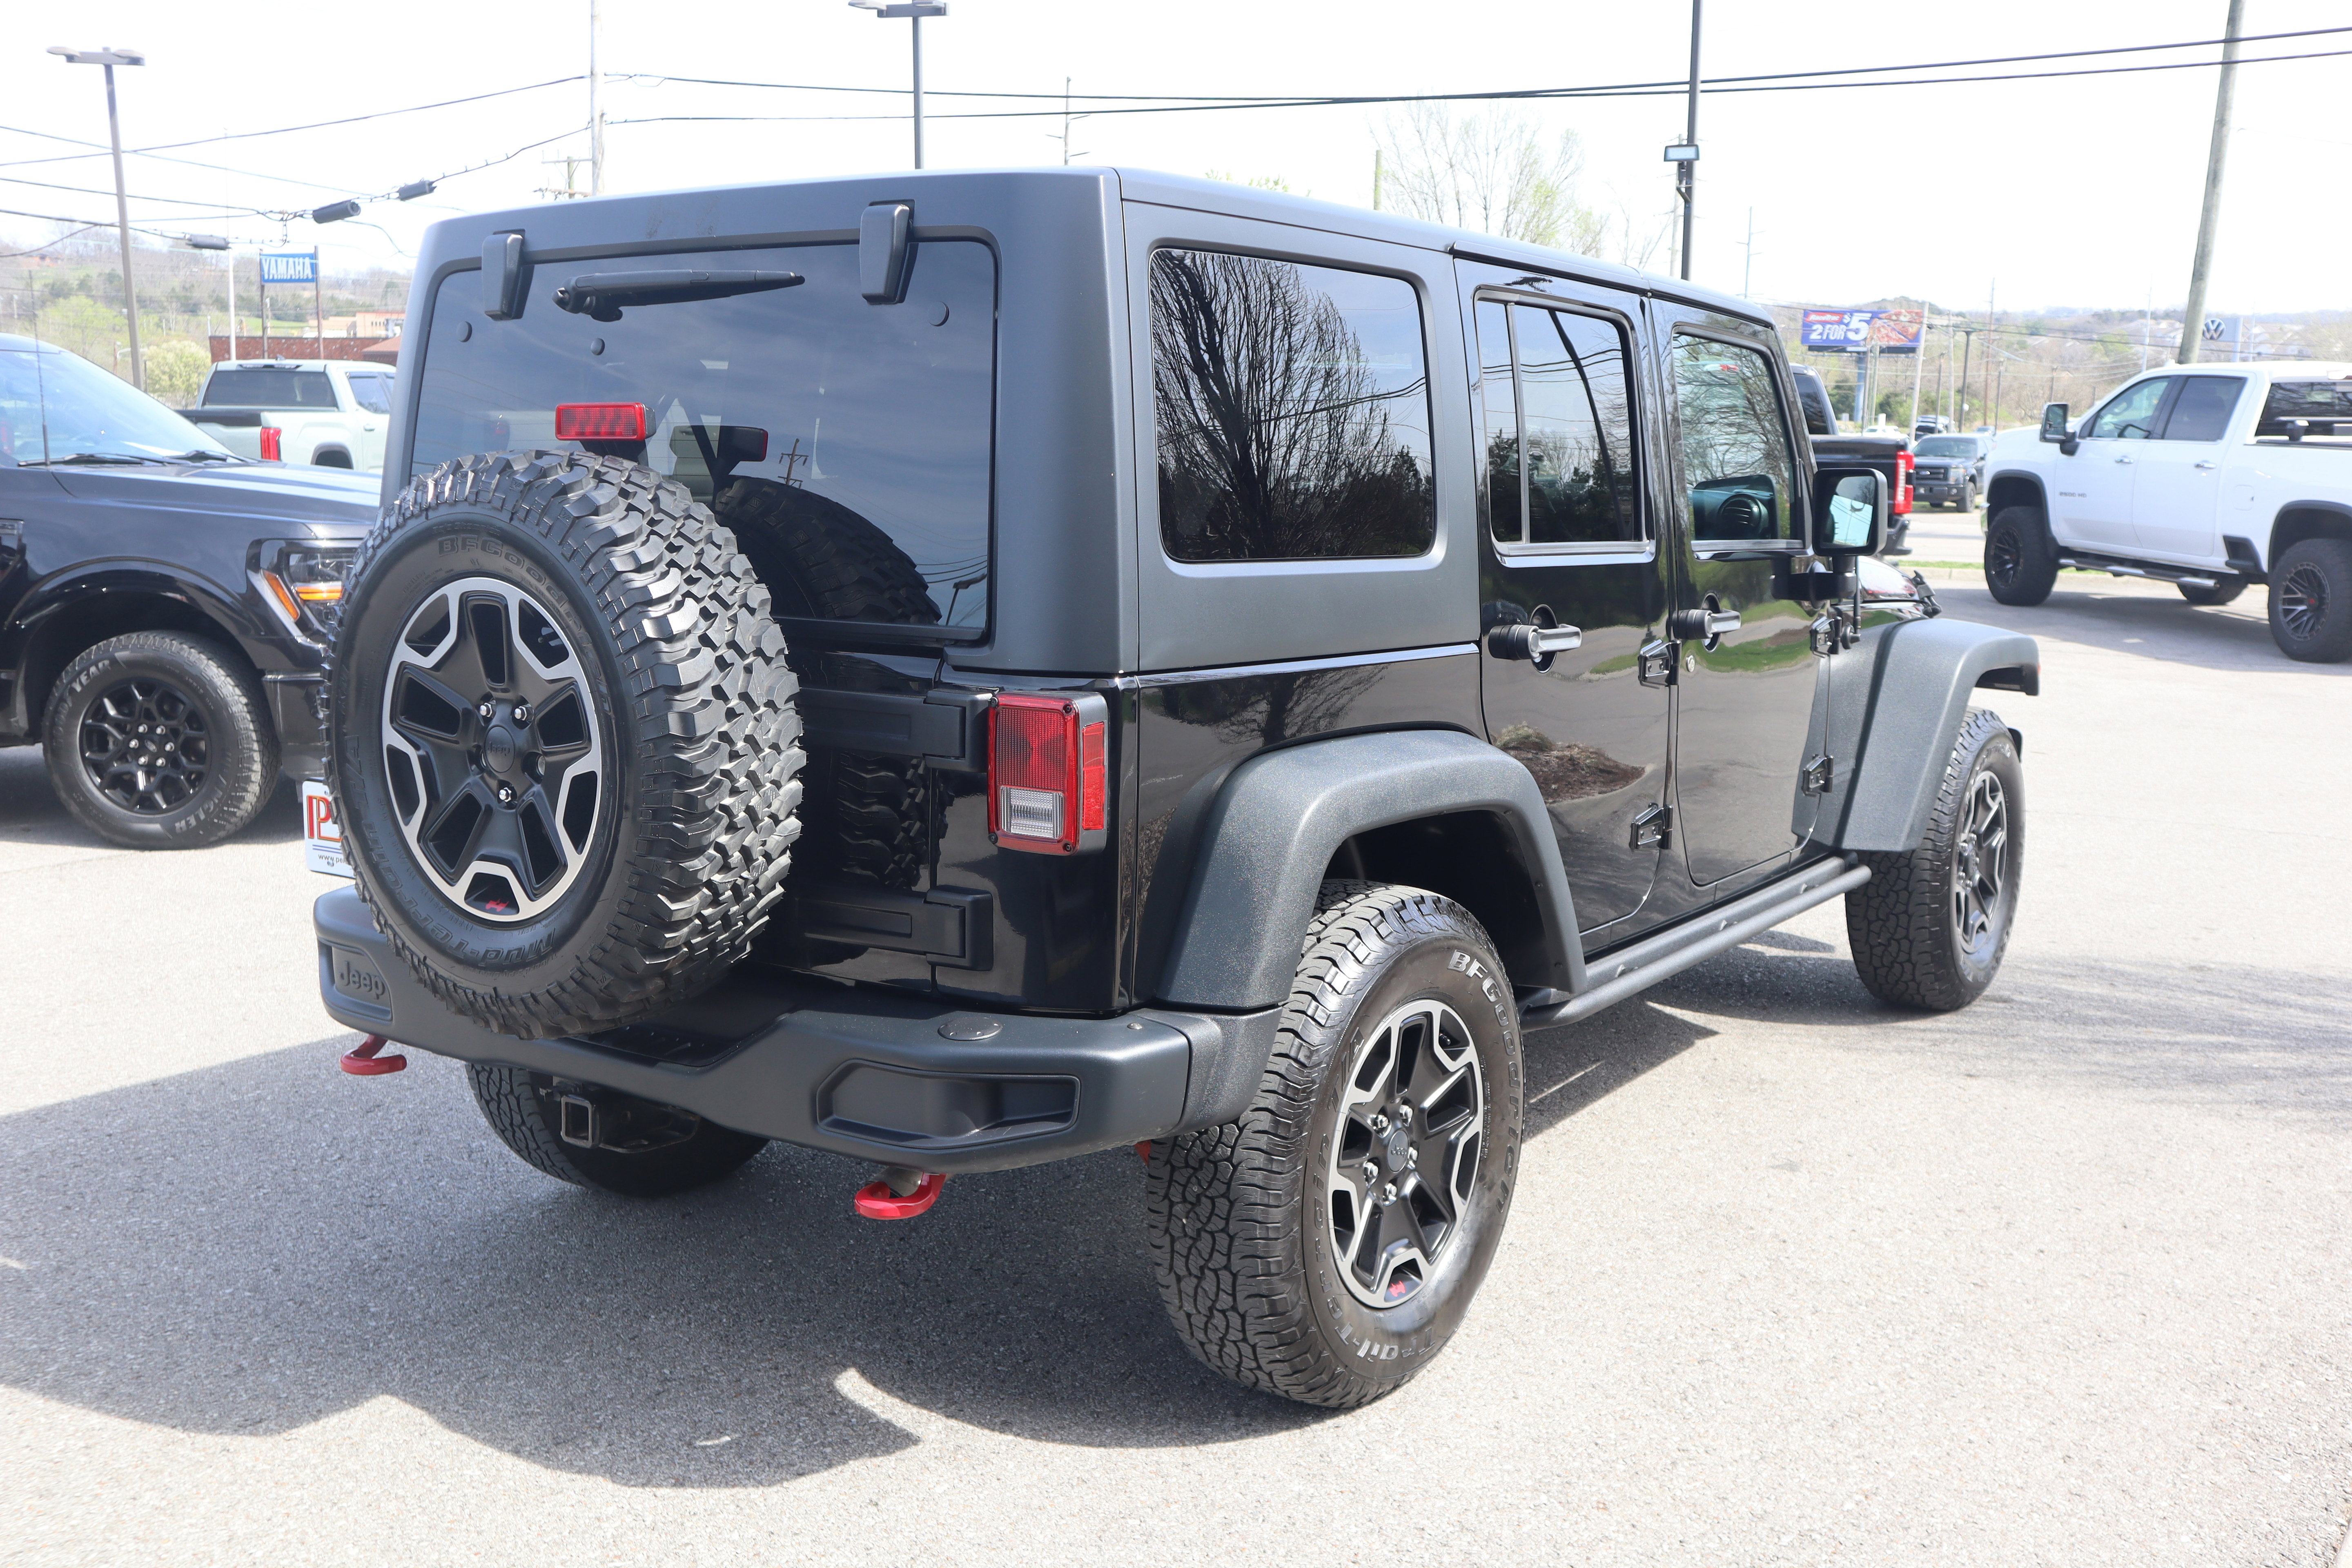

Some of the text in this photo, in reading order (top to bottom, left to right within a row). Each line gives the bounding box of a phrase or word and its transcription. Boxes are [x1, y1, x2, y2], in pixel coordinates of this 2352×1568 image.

[262, 257, 312, 279] YAMAHA
[1809, 324, 1824, 340] 2
[1823, 324, 1847, 340] FOR
[438, 534, 612, 717] BFGoodrich
[487, 741, 510, 757] Jeep
[362, 820, 555, 967] Mud-Terrain
[340, 960, 385, 1000] Jeep
[1447, 949, 1520, 1214] BFGoodrich
[1391, 1144, 1407, 1158] Jeep
[1314, 1134, 1435, 1363] Trail-Terrain
